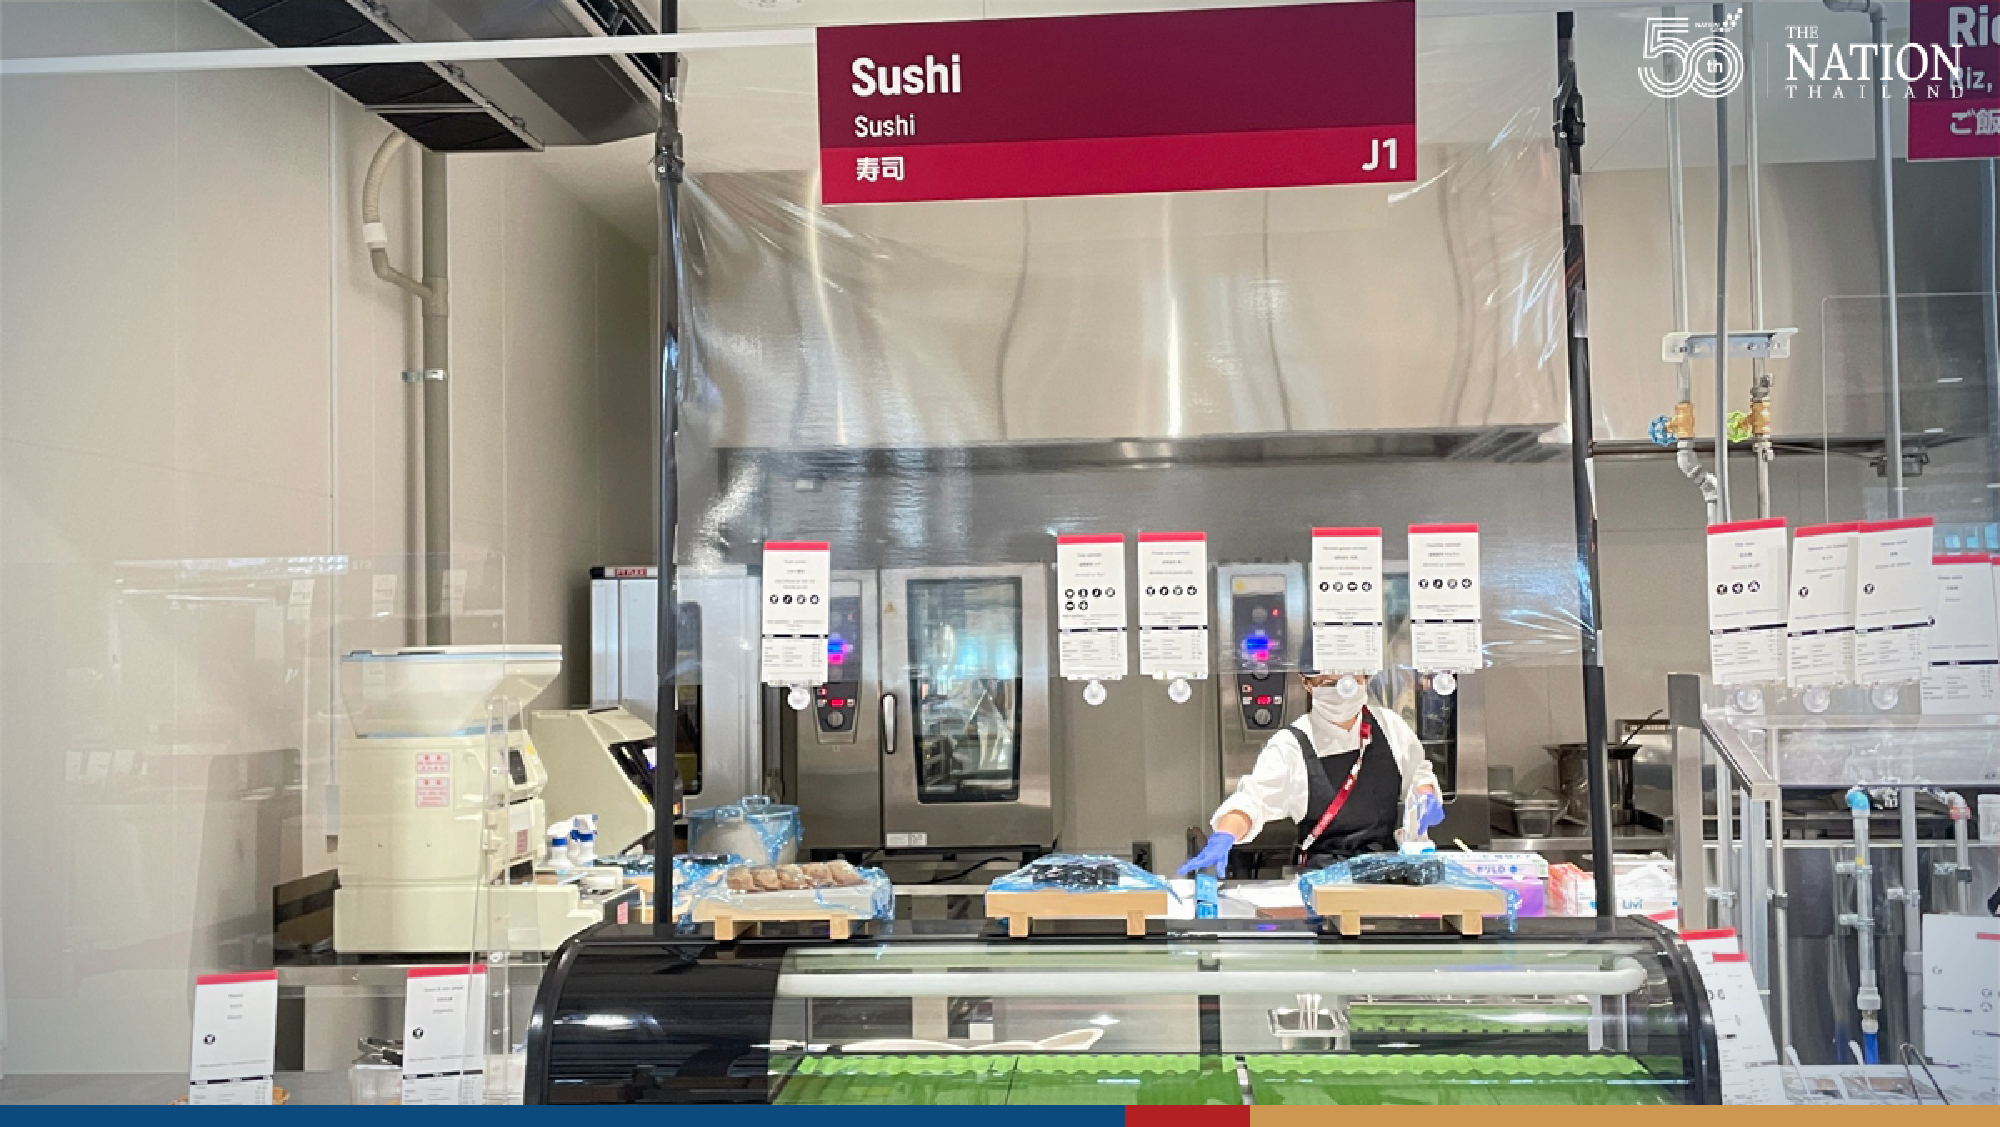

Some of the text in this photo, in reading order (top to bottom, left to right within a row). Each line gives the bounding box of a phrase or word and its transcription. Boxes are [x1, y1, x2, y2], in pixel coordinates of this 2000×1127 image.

[852, 53, 961, 98] Sushi
[854, 113, 916, 138] Sushi
[855, 156, 906, 183] 寿司
[1361, 138, 1398, 171] J1
